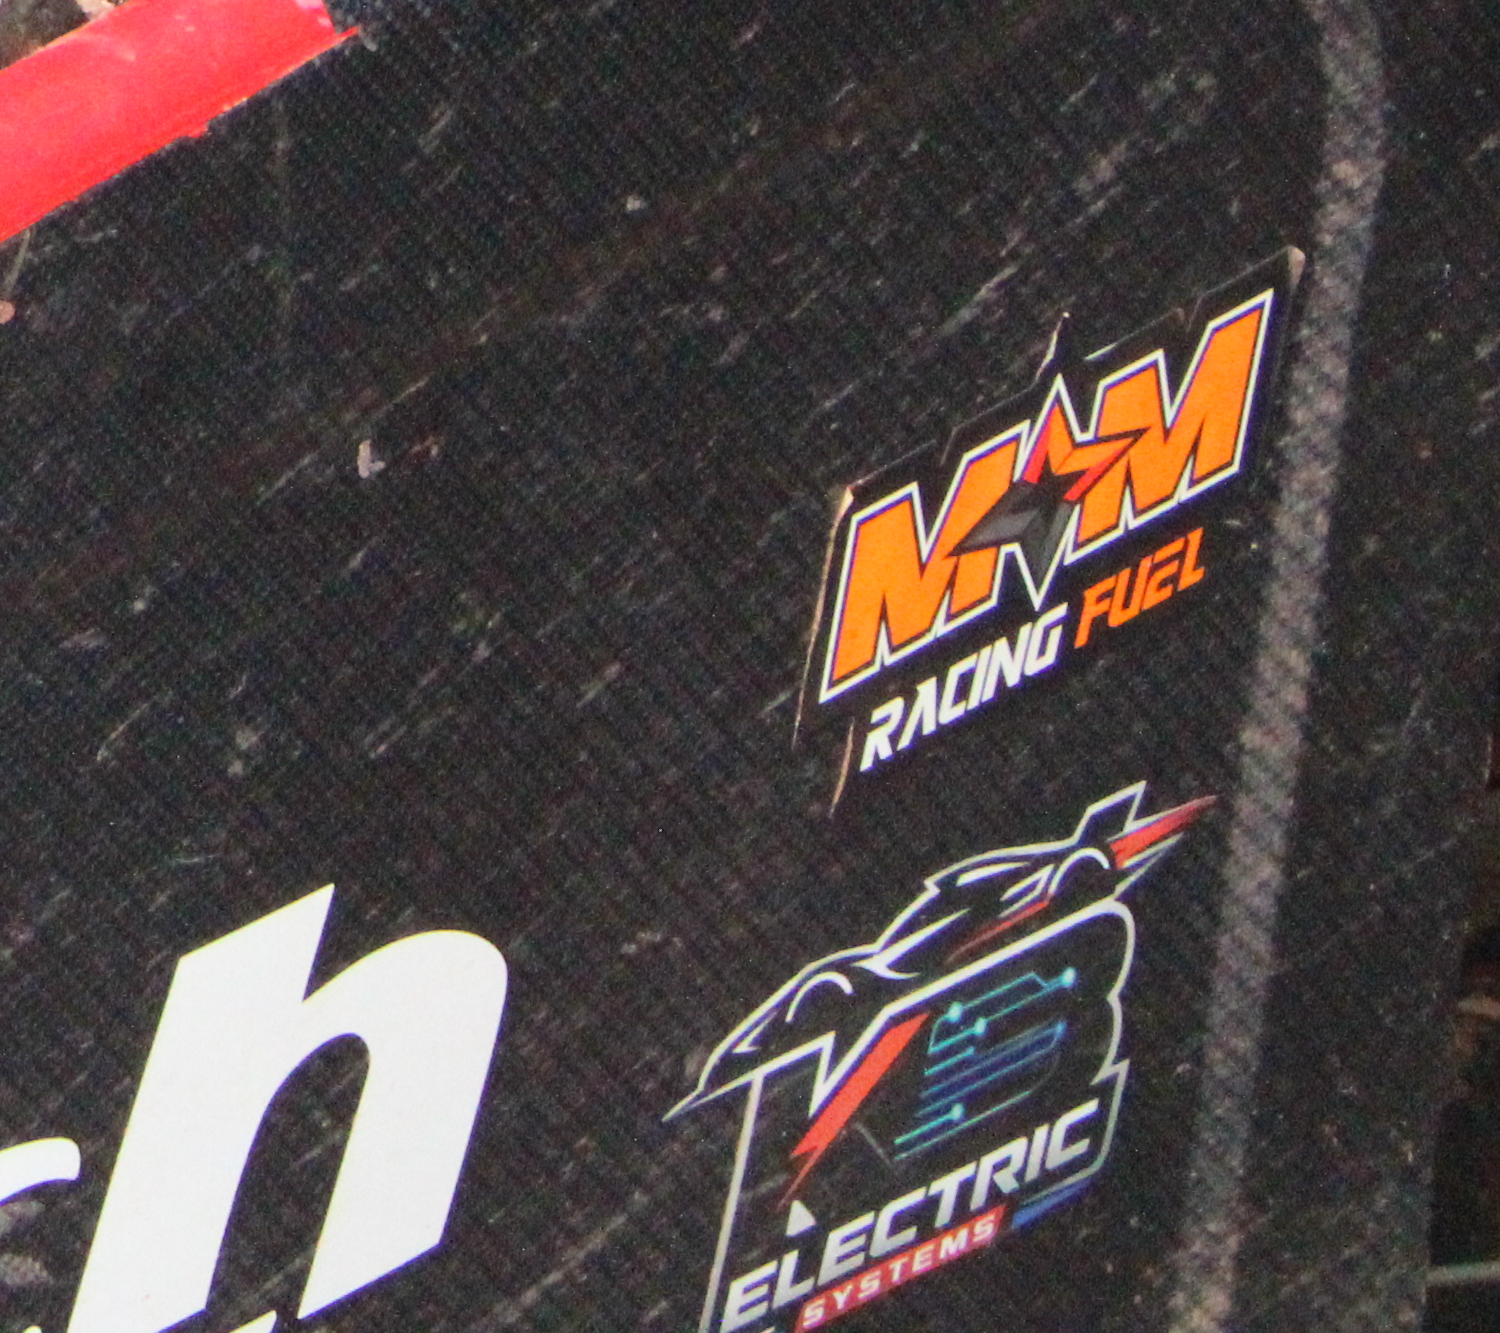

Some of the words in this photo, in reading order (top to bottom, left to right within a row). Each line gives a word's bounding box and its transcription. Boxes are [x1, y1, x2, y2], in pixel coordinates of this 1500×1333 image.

[859, 602, 1068, 773] RACING
[1073, 528, 1206, 649] FUEL
[719, 1098, 1100, 1333] ELECTRIC
[802, 1219, 997, 1331] SYSTEMS
